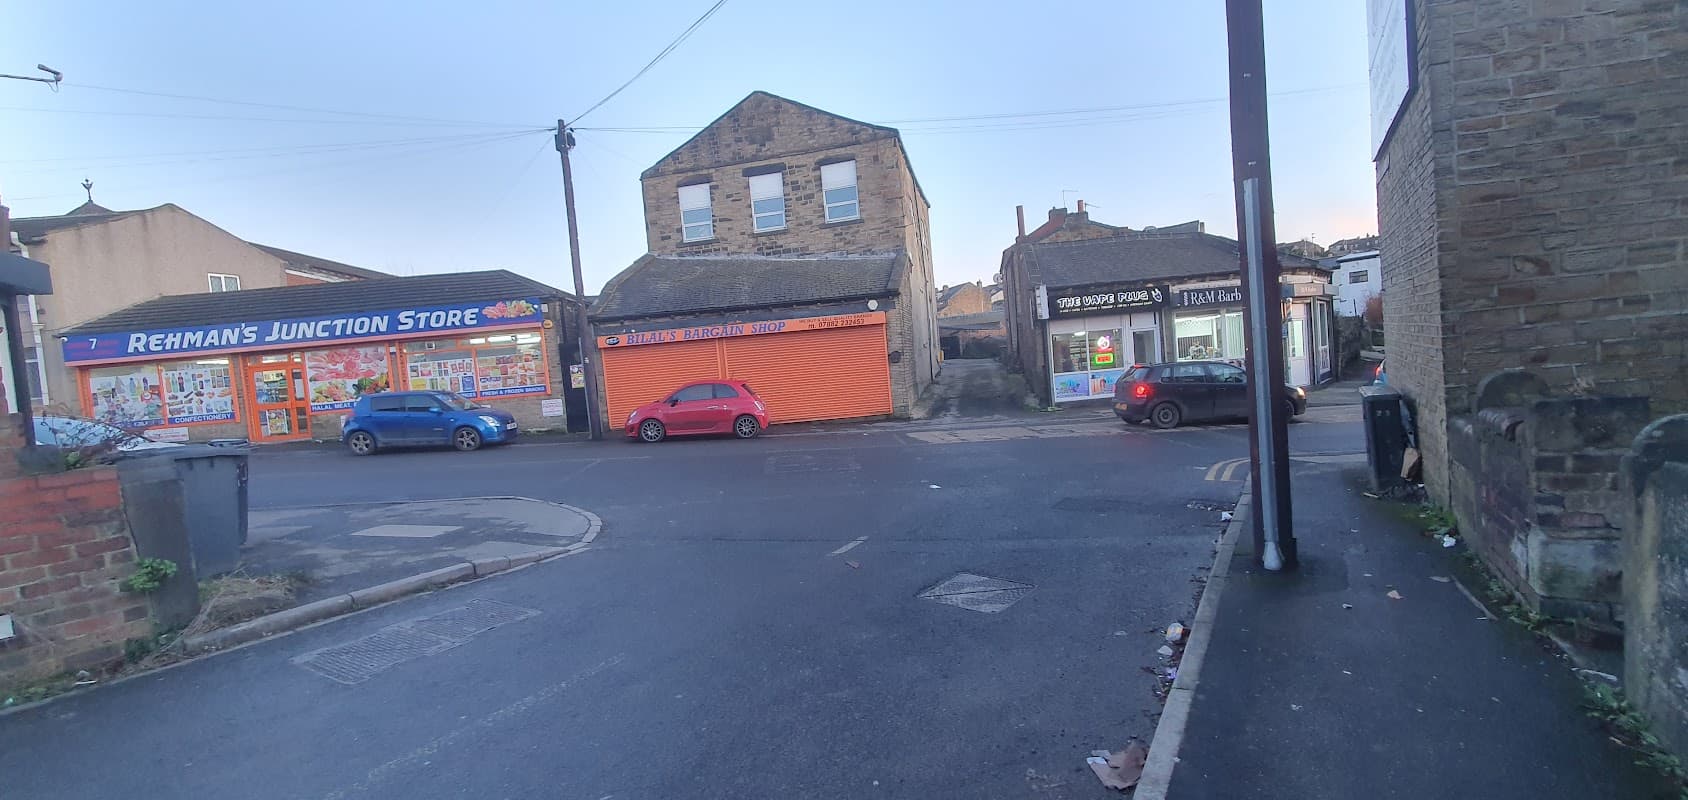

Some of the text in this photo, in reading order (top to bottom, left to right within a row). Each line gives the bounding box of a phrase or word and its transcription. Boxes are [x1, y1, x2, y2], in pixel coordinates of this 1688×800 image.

[1057, 296, 1081, 308] THE
[1083, 294, 1115, 306] VAPE
[1118, 290, 1149, 302] PLUG
[1191, 290, 1215, 305] R&M
[128, 308, 480, 353] REHMAN'S JUNCTION STORE
[627, 331, 677, 344] BILAL'S
[683, 325, 744, 339] BARGAIN
[751, 321, 786, 334] SHOP
[88, 337, 98, 350] 7
[312, 403, 333, 411] HALAL
[175, 412, 232, 424] CONFECTIONERY
